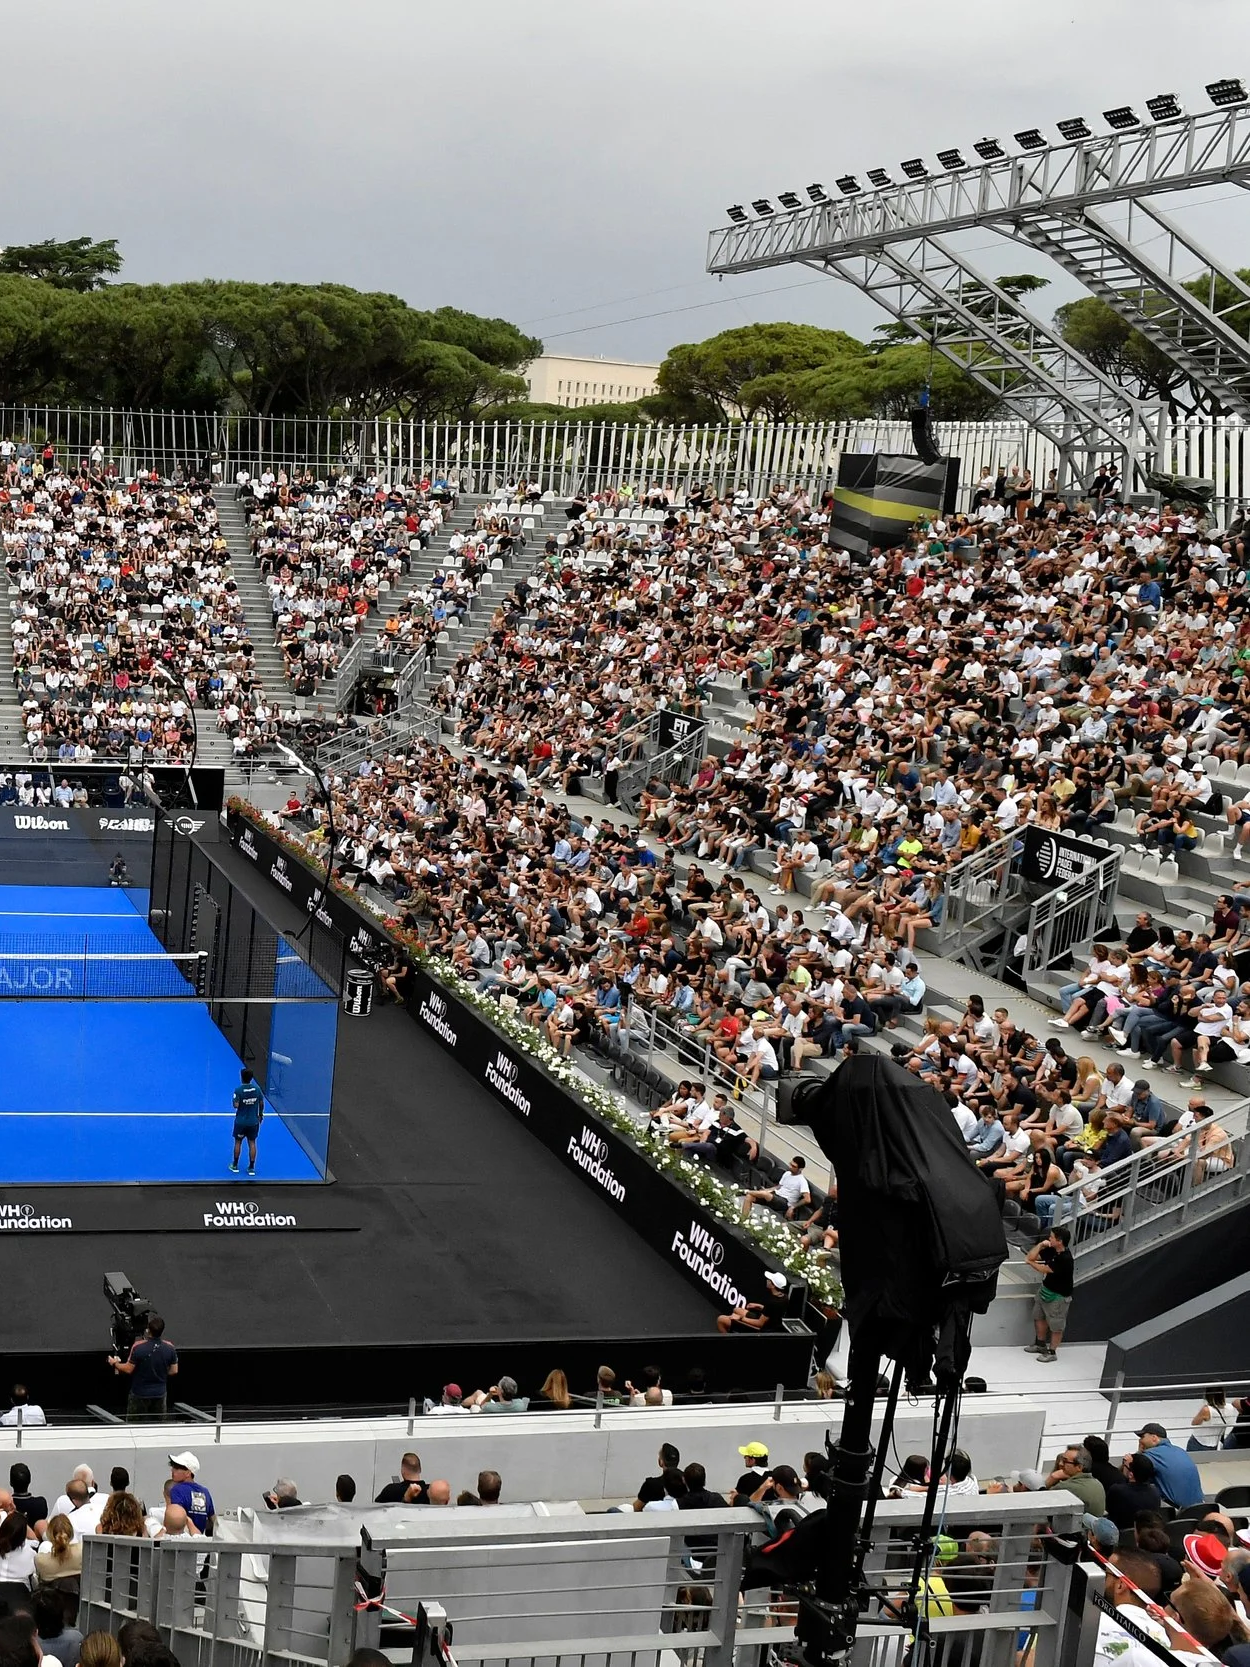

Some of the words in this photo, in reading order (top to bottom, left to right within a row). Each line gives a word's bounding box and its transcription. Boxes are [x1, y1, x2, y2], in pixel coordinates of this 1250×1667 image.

[13, 815, 70, 831] Wilson
[1056, 856, 1073, 871] PADEL
[419, 1001, 458, 1047] Foundation
[484, 1062, 531, 1117] Foundation
[566, 1136, 626, 1203] Foundation
[203, 1212, 297, 1228] Foundation
[671, 1230, 747, 1309] Foundation
[1094, 1595, 1115, 1617] FORO
[1116, 1613, 1146, 1642] ITALICO
